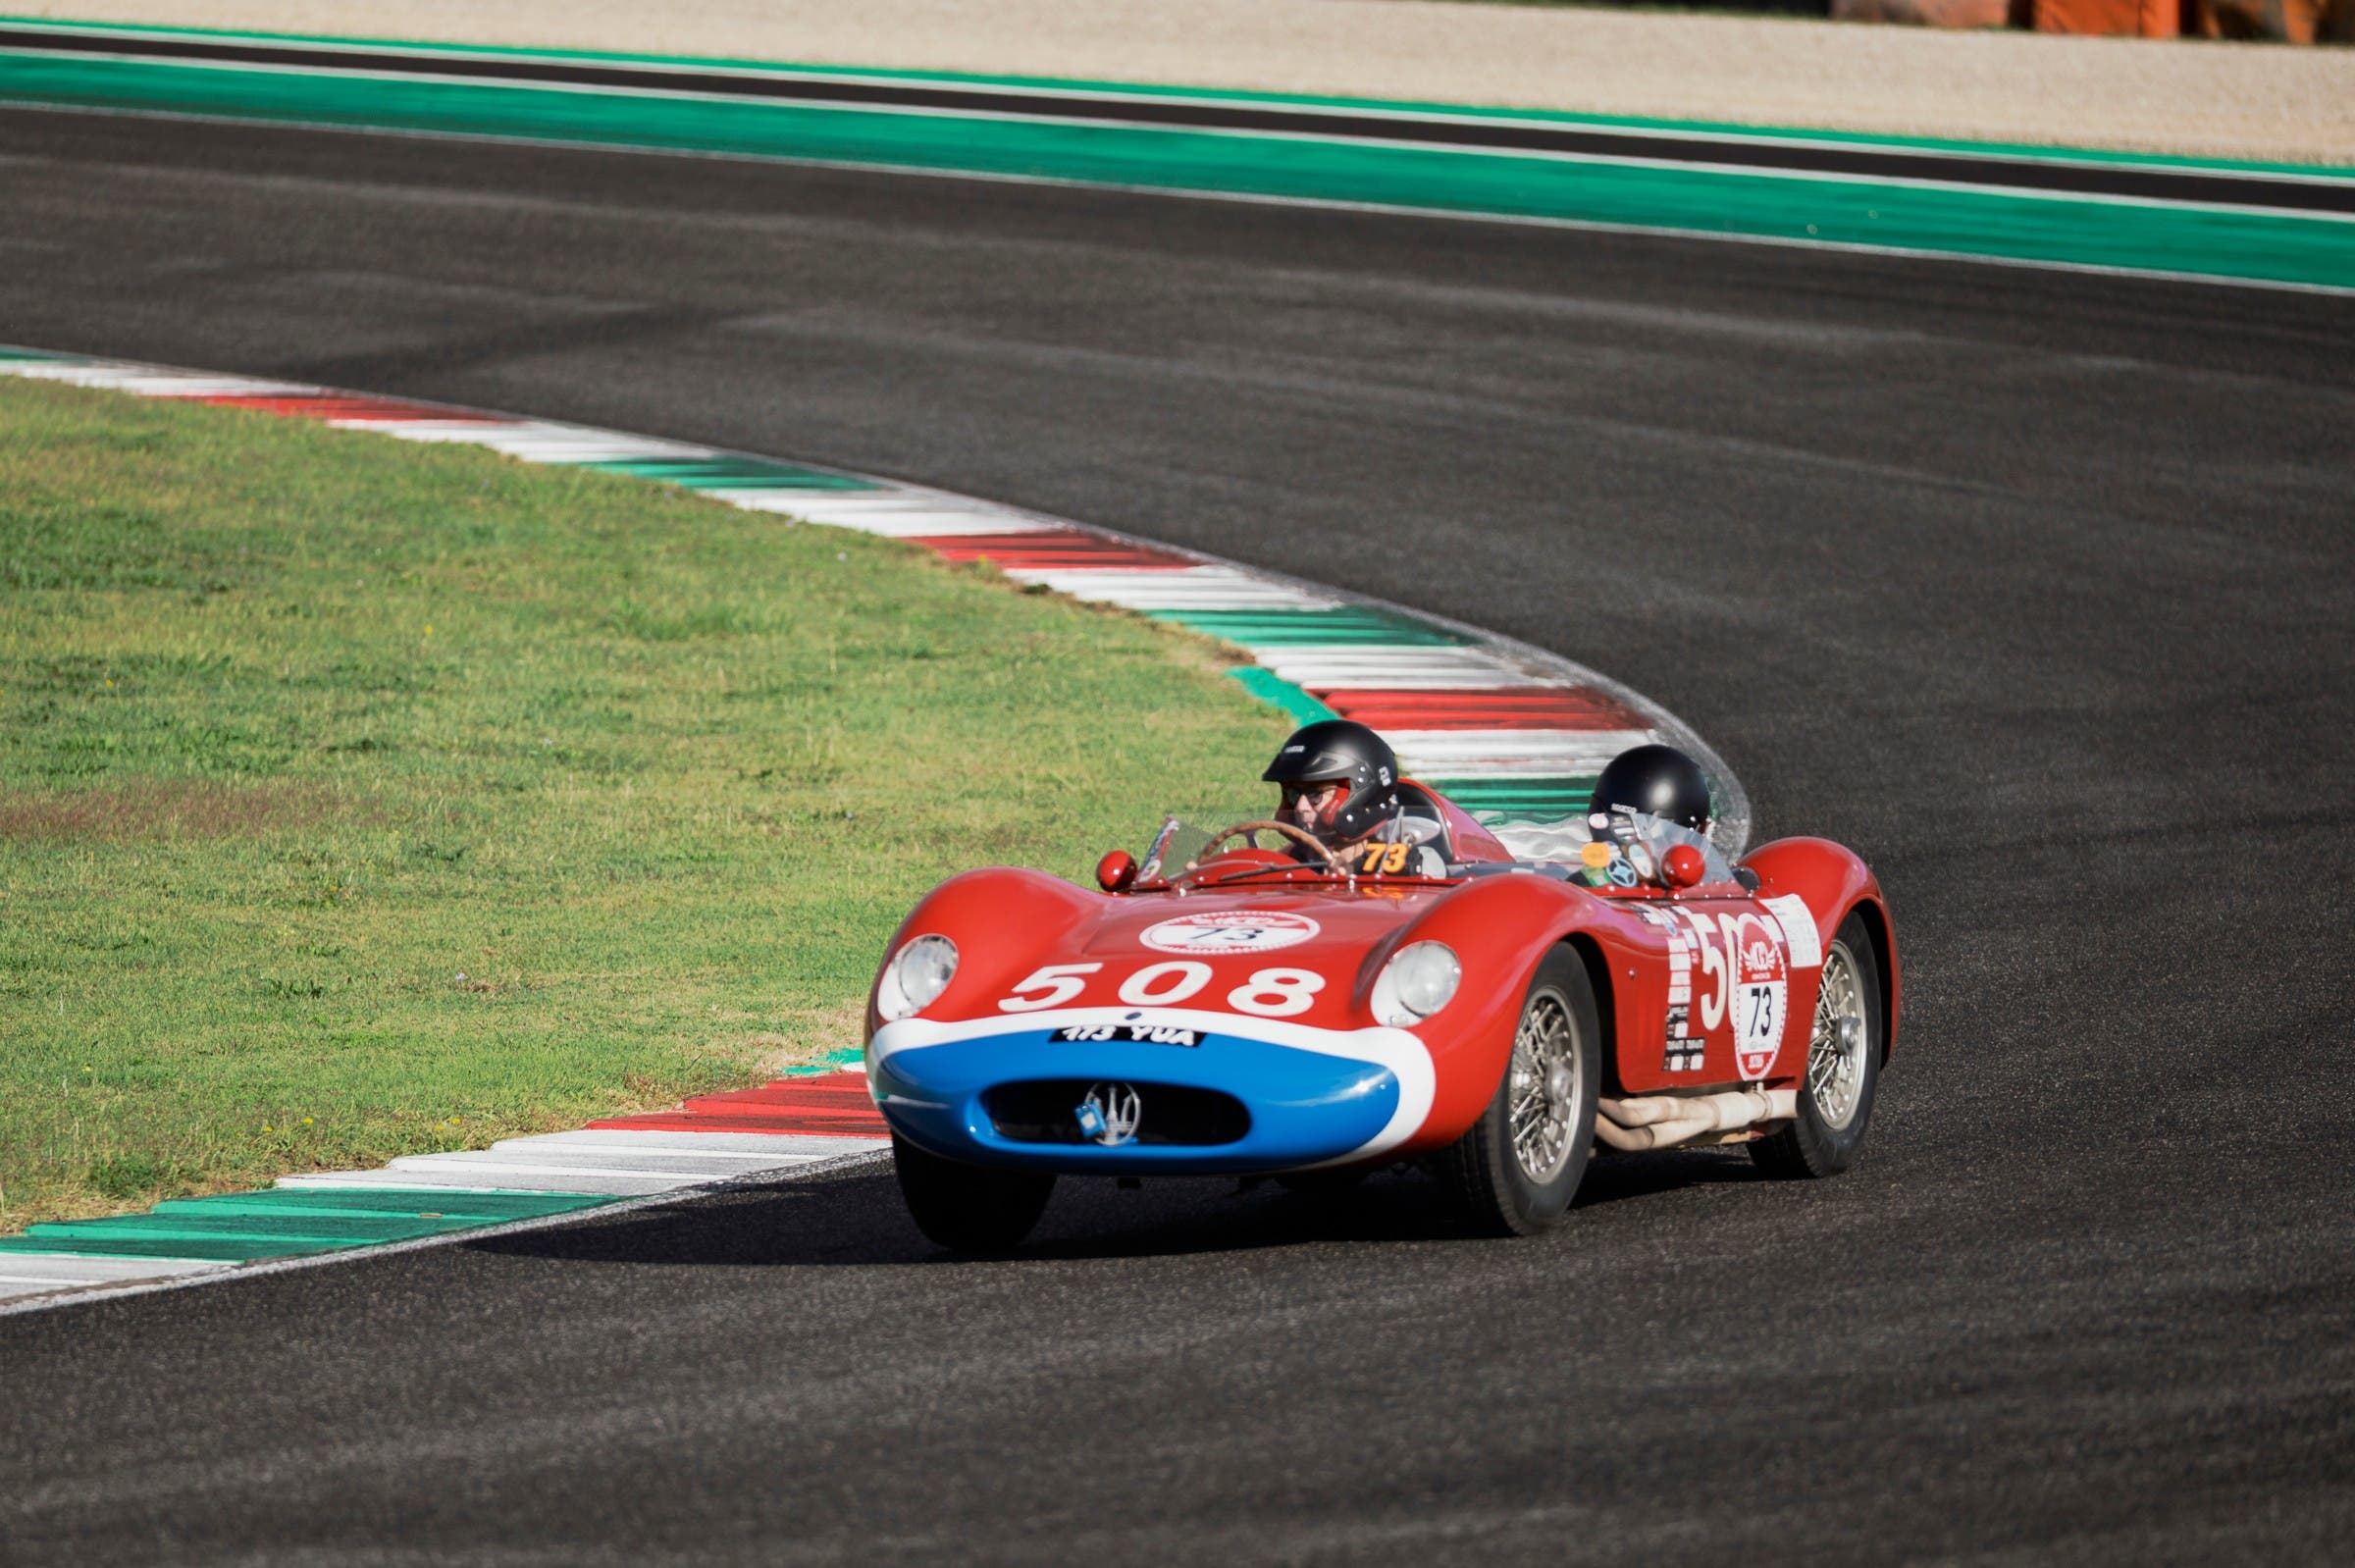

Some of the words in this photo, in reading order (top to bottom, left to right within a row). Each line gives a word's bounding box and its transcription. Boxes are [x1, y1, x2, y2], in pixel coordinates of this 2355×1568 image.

[1362, 843, 1409, 873] 73
[1188, 926, 1264, 941] 73
[998, 961, 1327, 1017] 508
[1749, 986, 1772, 1037] 73
